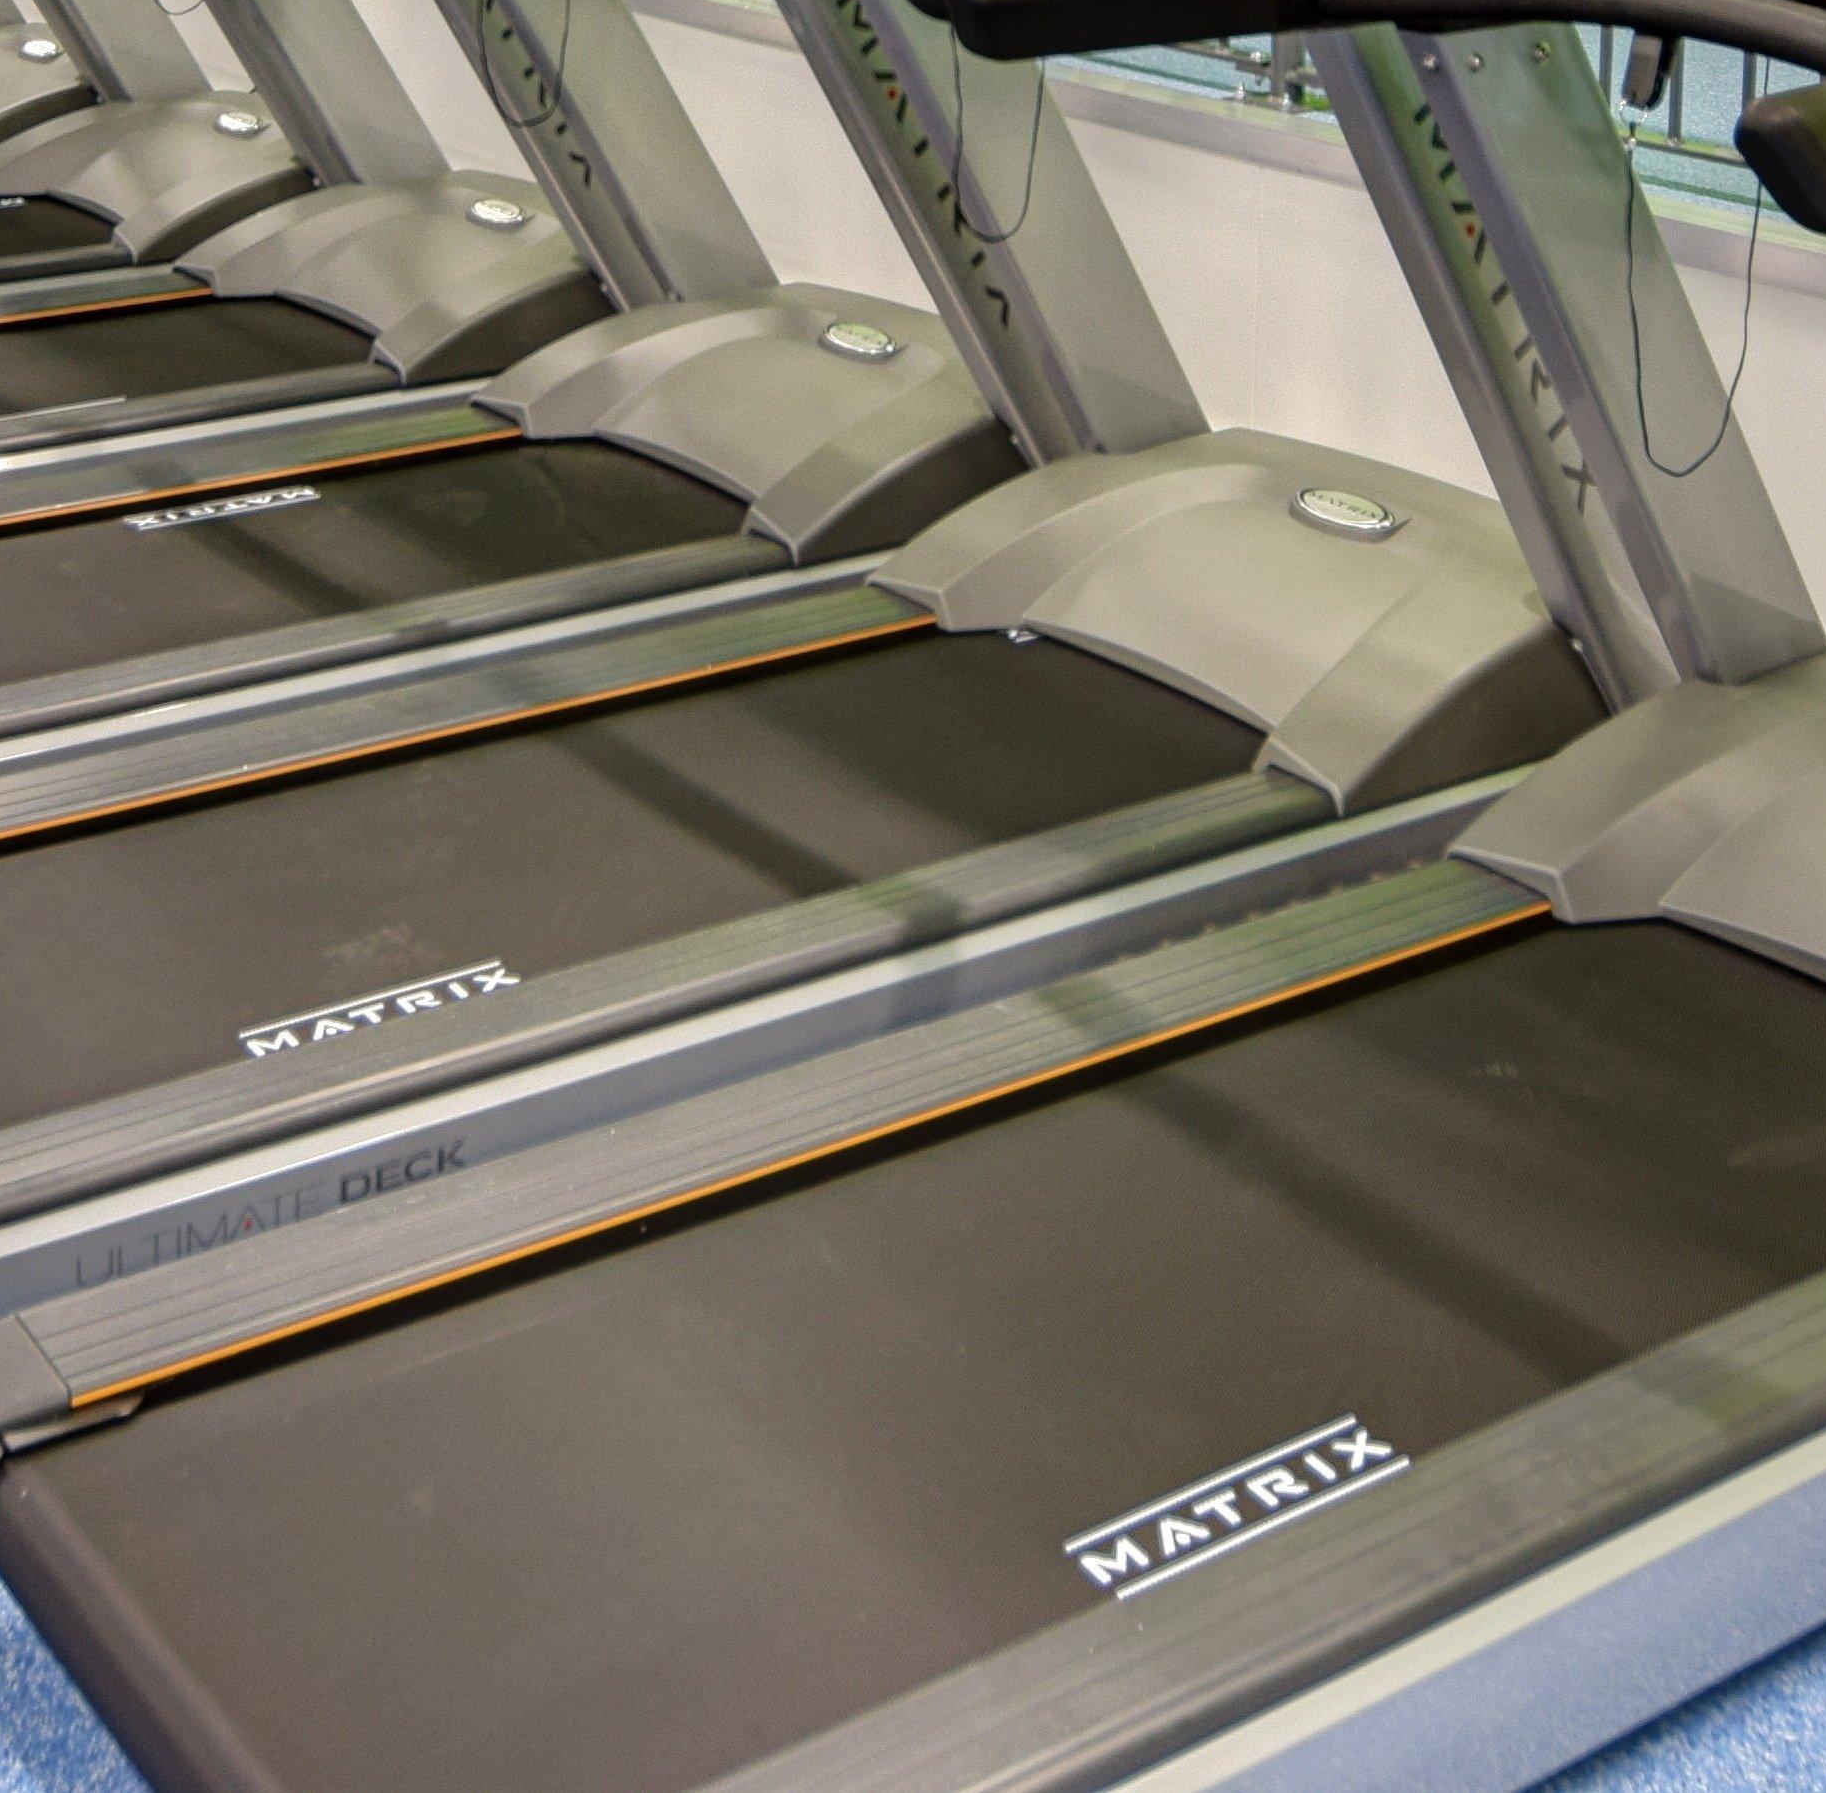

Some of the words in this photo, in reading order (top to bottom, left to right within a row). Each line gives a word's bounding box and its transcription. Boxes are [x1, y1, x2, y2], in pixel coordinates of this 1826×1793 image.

[245, 967, 522, 1058] MATRIX
[339, 1140, 466, 1204] DECK
[1079, 1425, 1393, 1587] MATRIX
